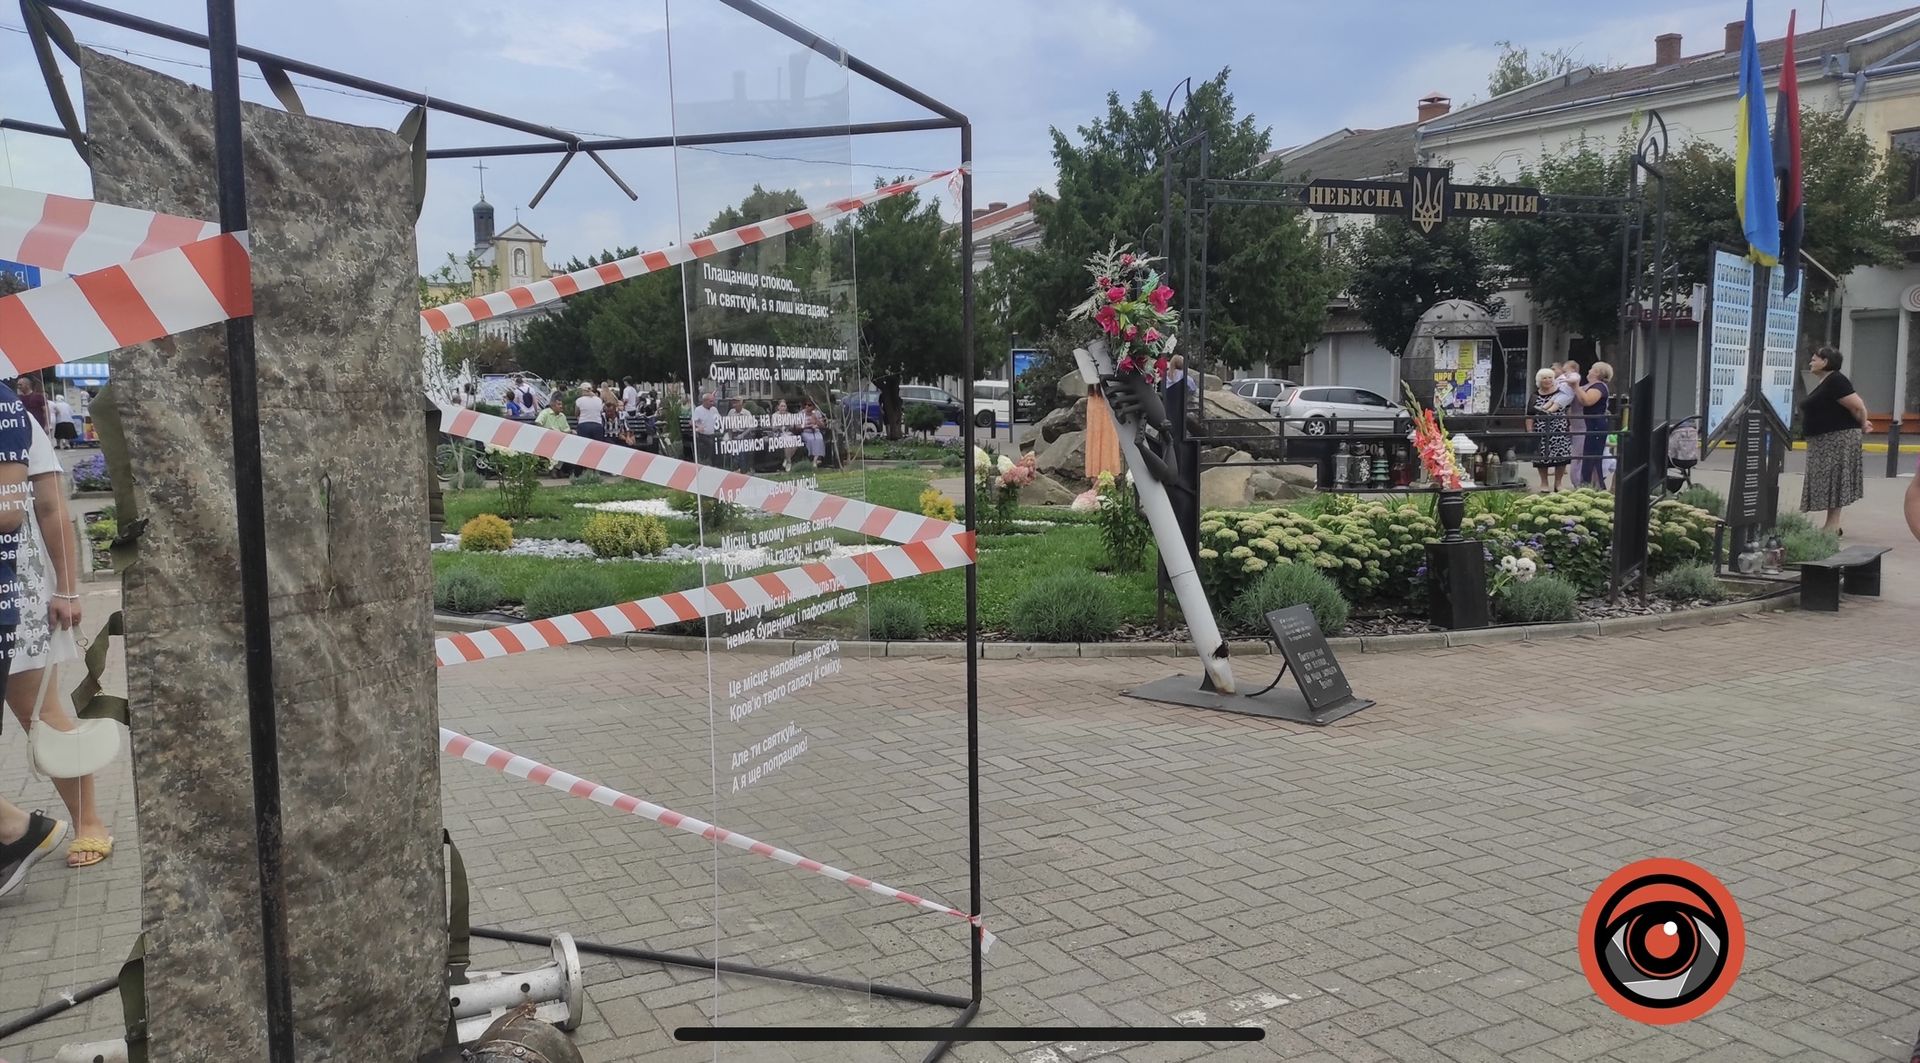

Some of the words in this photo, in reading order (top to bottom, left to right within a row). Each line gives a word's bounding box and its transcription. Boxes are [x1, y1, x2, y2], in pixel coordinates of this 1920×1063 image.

[1309, 186, 1404, 208] НЕБЕСНА
[1454, 191, 1539, 215] ГВАРДІЯ
[703, 263, 759, 288] Плащаниця
[761, 274, 800, 293] спокою...
[704, 288, 717, 306] Ти
[719, 293, 760, 314] святкуй,
[762, 300, 767, 311] а
[768, 300, 774, 312] я
[775, 300, 793, 315] лиш
[730, 344, 767, 358] живемо
[769, 346, 774, 358] в
[776, 344, 831, 363] двовимірному
[832, 346, 848, 361] світі
[709, 364, 736, 383] Один
[737, 366, 773, 383] далеко,
[774, 369, 780, 381] а
[781, 365, 805, 382] інший
[806, 369, 824, 384] десь
[714, 413, 758, 434] Зупинись
[760, 415, 771, 427] на
[772, 412, 806, 428] хвилину
[715, 439, 719, 455] і
[720, 437, 764, 456] подивися
[721, 531, 750, 552] Місці,
[751, 534, 757, 546] в
[758, 526, 786, 545] якому
[787, 519, 811, 538] немає
[805, 541, 812, 555] ні
[725, 609, 731, 626] В
[734, 601, 762, 624] цьому
[726, 631, 755, 650] немає
[757, 616, 797, 640] буденних
[797, 611, 801, 624] і
[801, 601, 838, 621] пафосних
[728, 681, 742, 698] Це
[743, 669, 768, 692] місце
[769, 649, 812, 678] наповнене
[730, 696, 762, 723] Кров'ю
[763, 685, 786, 706] твого
[787, 671, 813, 696] галасу
[814, 667, 820, 682] й
[731, 750, 749, 770] Але
[750, 742, 761, 760] ти
[732, 776, 740, 794] А
[740, 774, 747, 790] я
[748, 765, 762, 784] ще
[763, 736, 808, 775] попрацюю!
